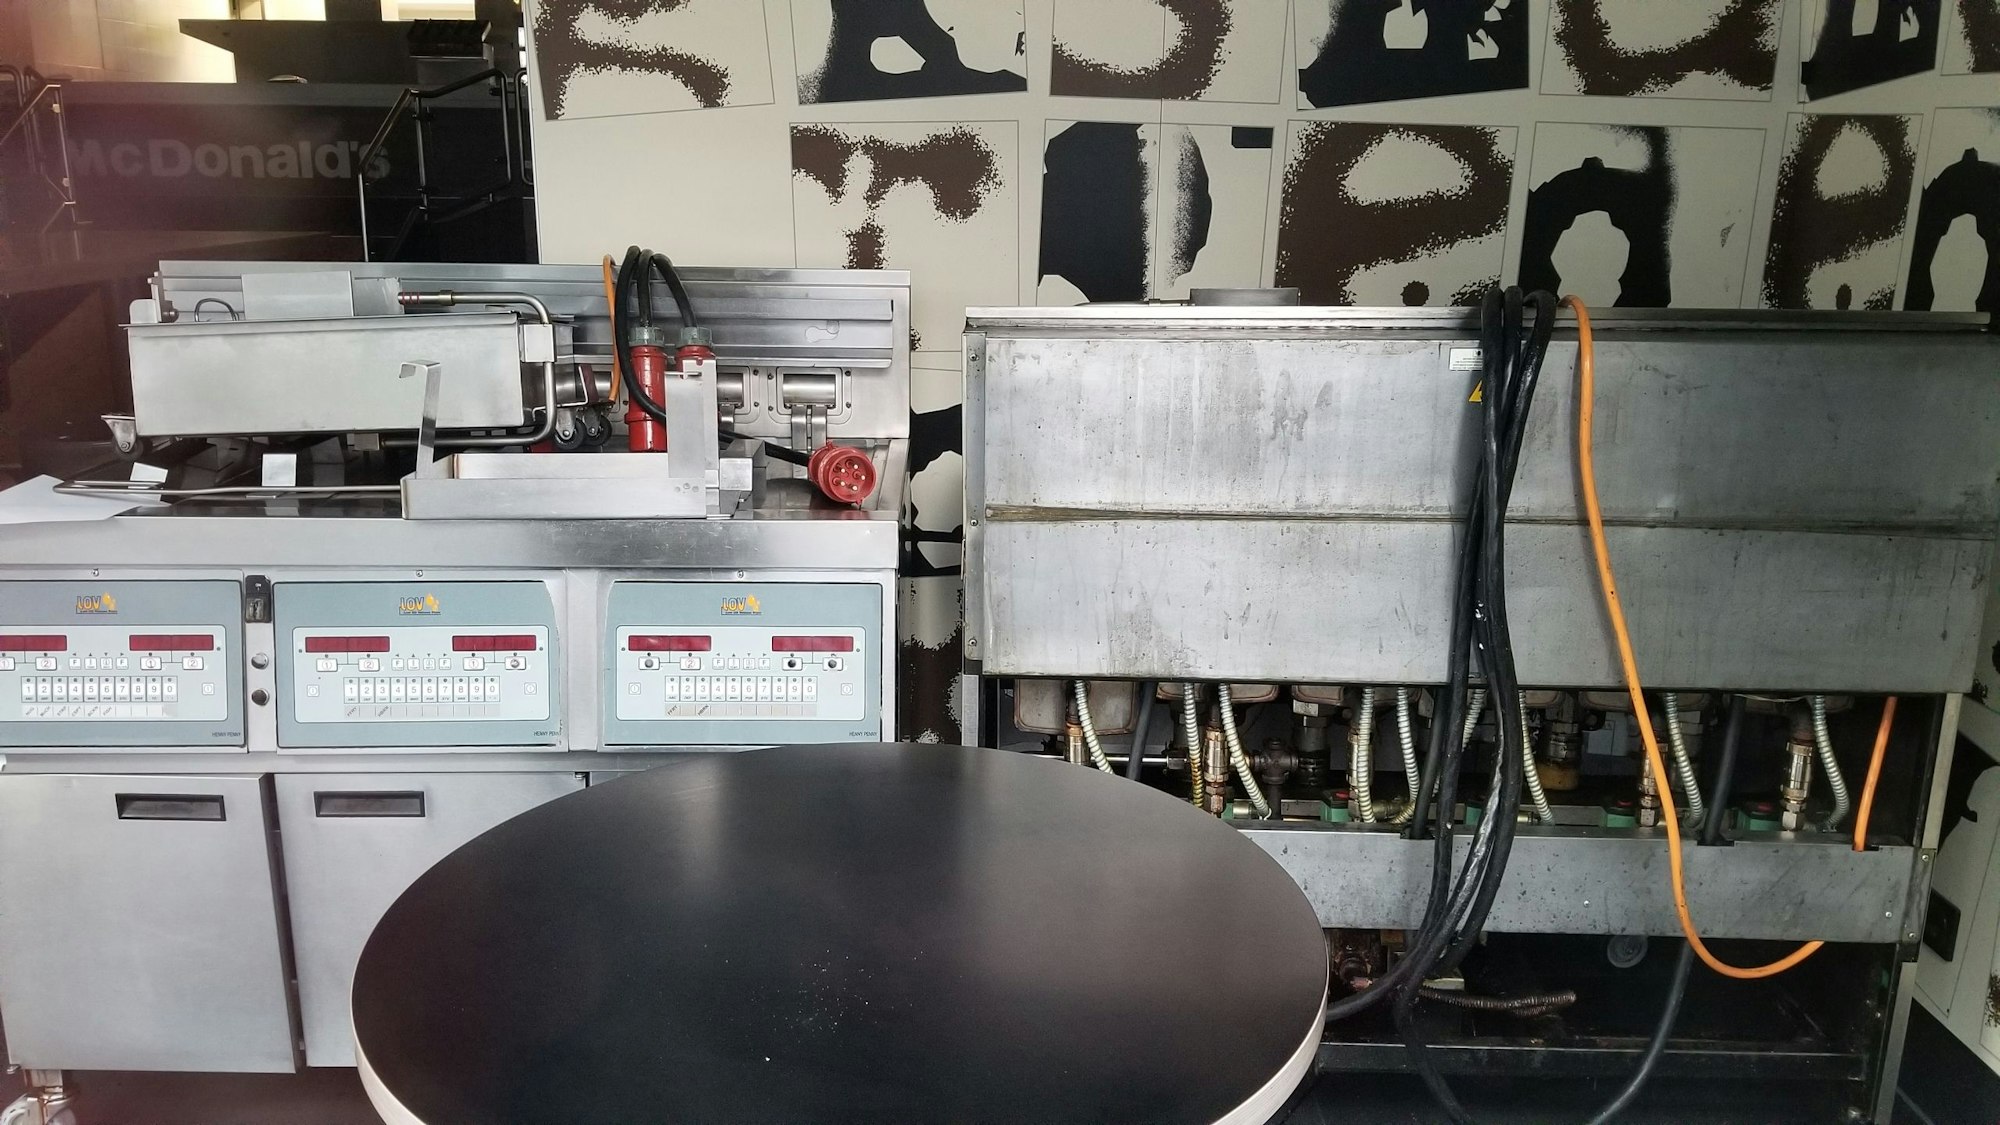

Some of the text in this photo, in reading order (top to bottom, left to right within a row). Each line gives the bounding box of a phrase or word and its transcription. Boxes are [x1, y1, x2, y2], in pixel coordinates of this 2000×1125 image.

[66, 138, 391, 179] McDonald's
[76, 596, 101, 610] LOV
[400, 596, 424, 611] LOV
[722, 597, 746, 611] LOV
